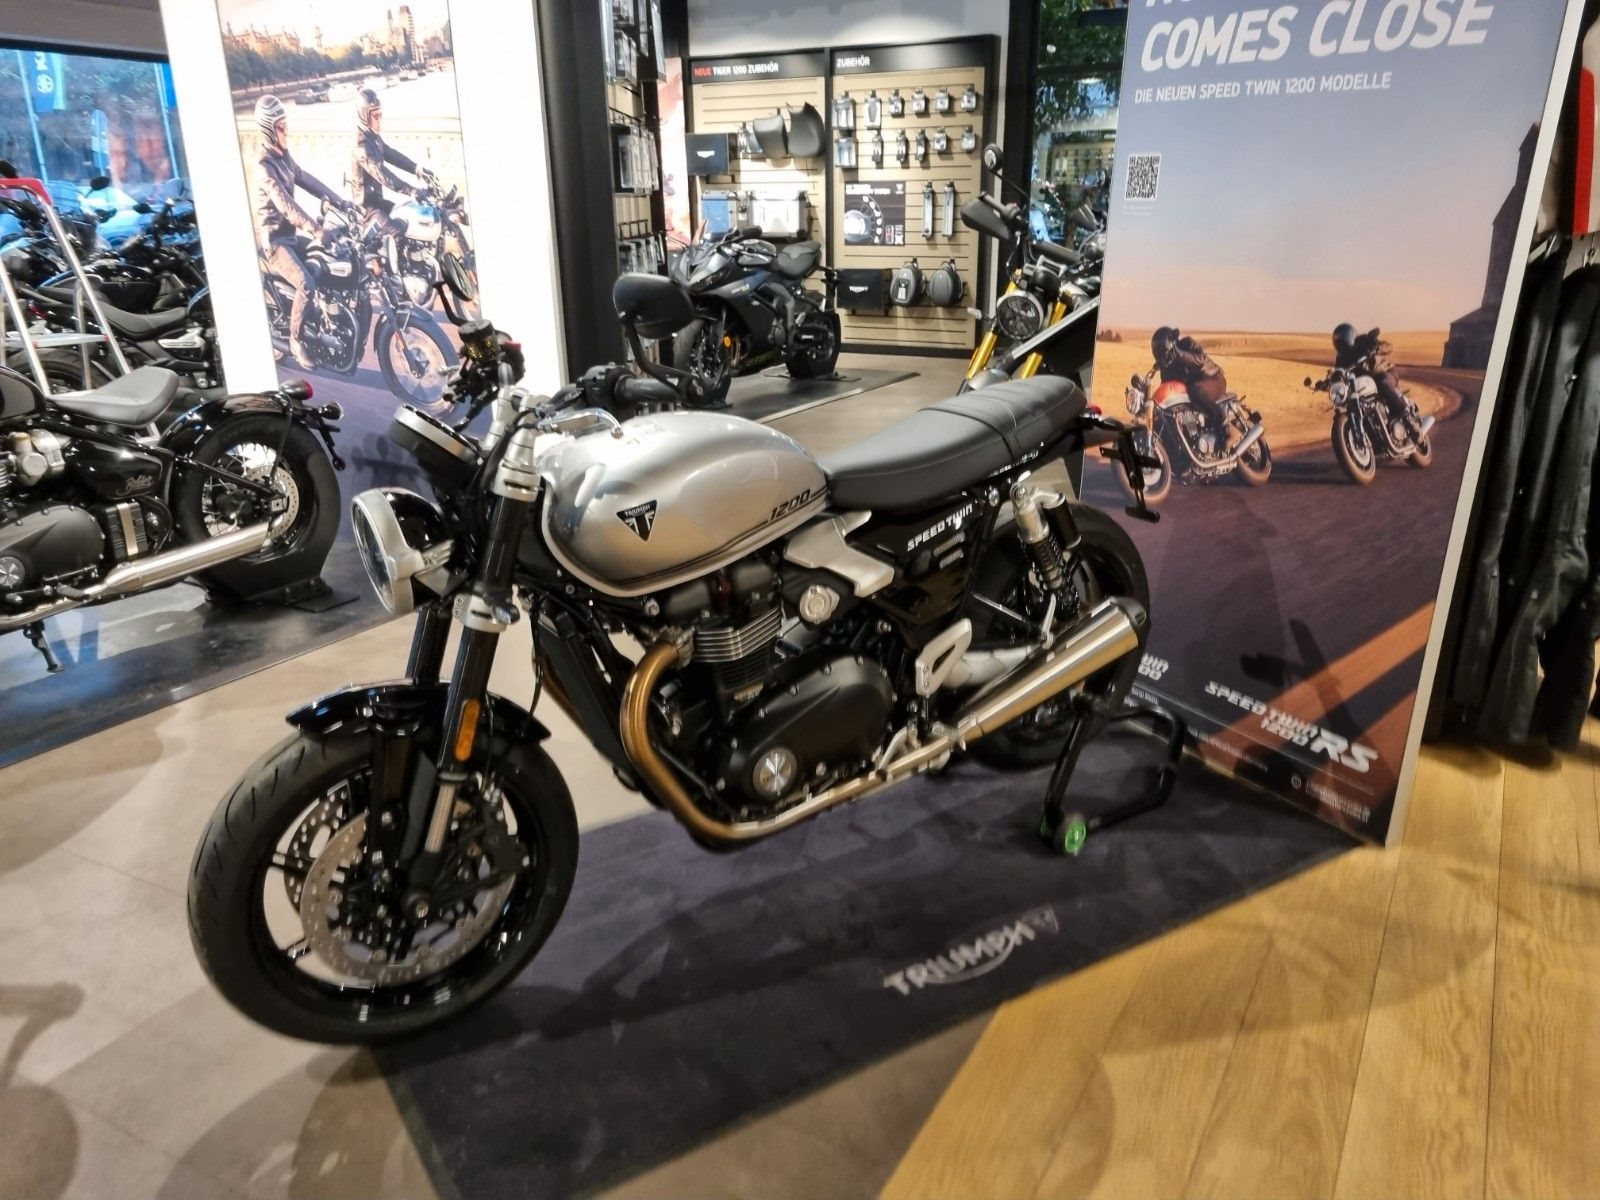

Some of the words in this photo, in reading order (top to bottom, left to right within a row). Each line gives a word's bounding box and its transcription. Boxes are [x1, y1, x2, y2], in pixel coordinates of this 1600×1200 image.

[1141, 5, 1299, 72] COMES
[1309, 0, 1494, 57] CLOSE
[713, 65, 732, 76] TIGER
[748, 61, 779, 73] ZUBEHÖR
[837, 55, 870, 68] ZUBEHÖR
[1135, 88, 1153, 104] DIE
[1156, 84, 1197, 101] NEUEN
[1200, 81, 1241, 98] SPEED
[1245, 79, 1281, 96] TWIN
[1286, 77, 1316, 93] 1200
[1319, 71, 1393, 92] MODELLE
[771, 489, 811, 520] 1200
[907, 520, 946, 552] SPEED
[1204, 680, 1268, 716] SPEED
[1269, 708, 1319, 739] TWIN
[1260, 716, 1310, 747] 1200
[1310, 727, 1379, 773] RS
[883, 920, 1036, 996] TRIUMPH
